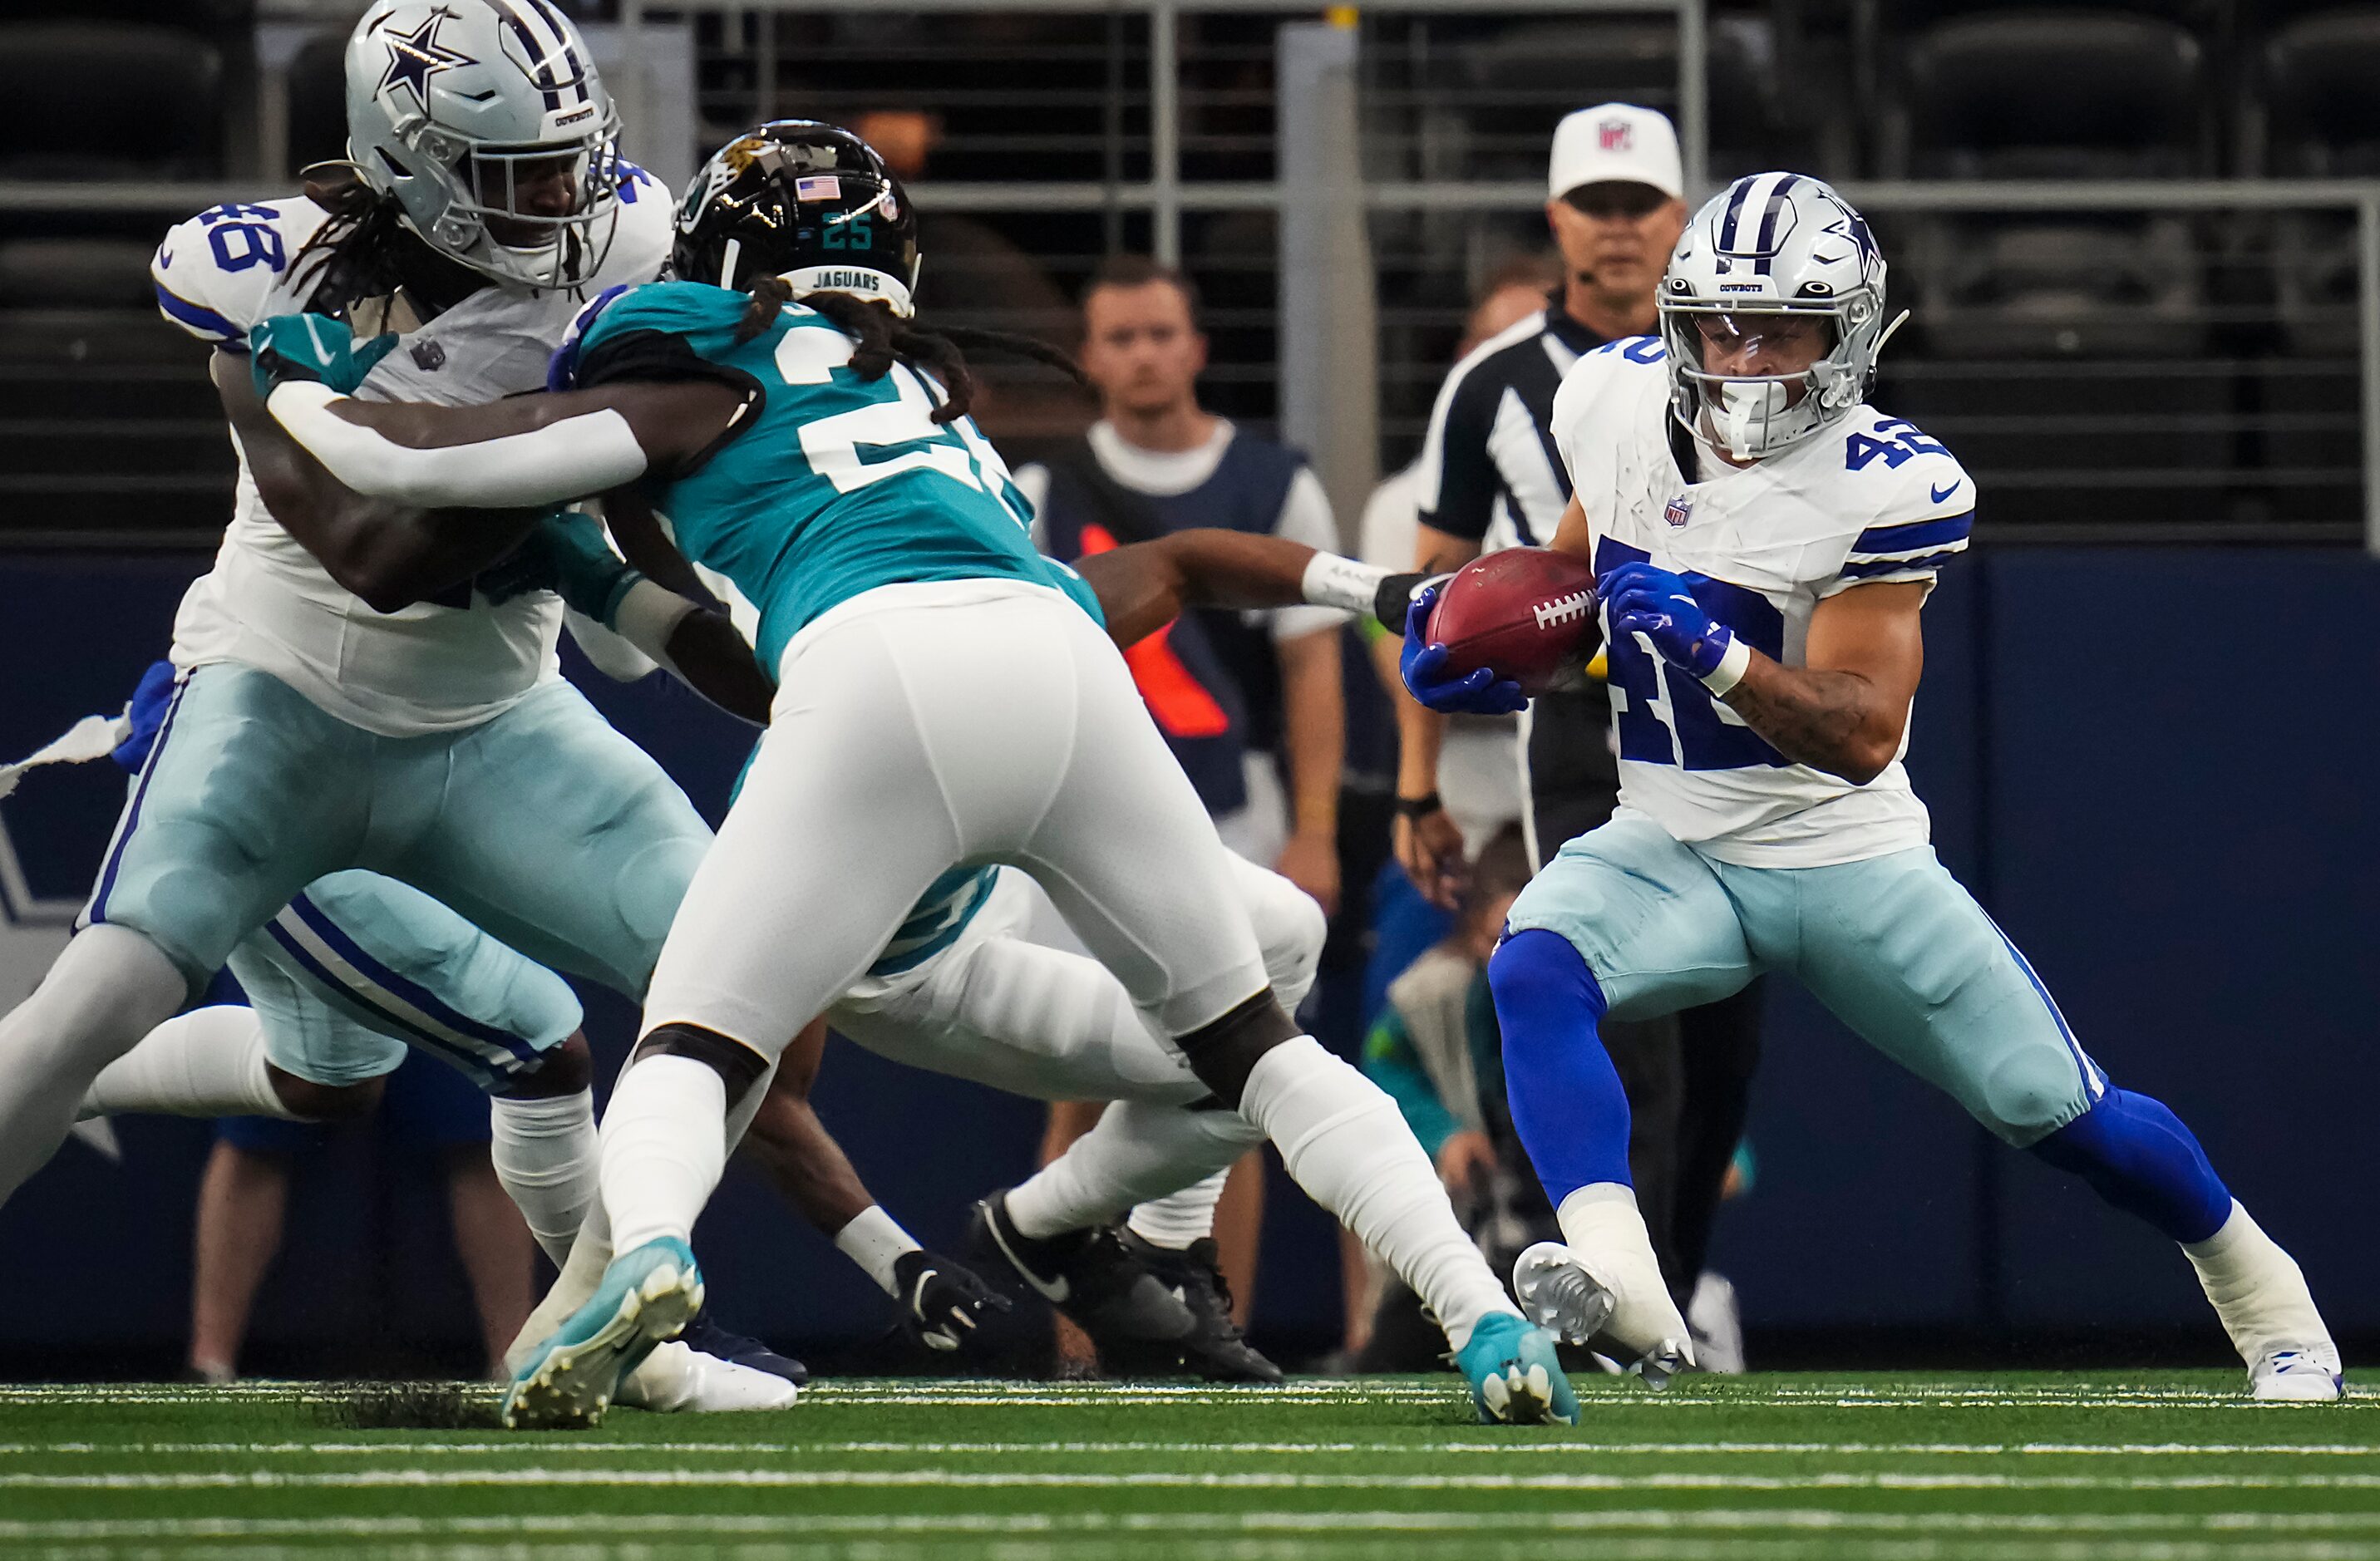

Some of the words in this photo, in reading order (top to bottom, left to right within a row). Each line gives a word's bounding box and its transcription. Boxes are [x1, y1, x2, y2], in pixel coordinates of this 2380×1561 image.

[822, 212, 871, 249] 25
[813, 271, 880, 291] JAGUARS
[1845, 418, 1954, 470] 42
